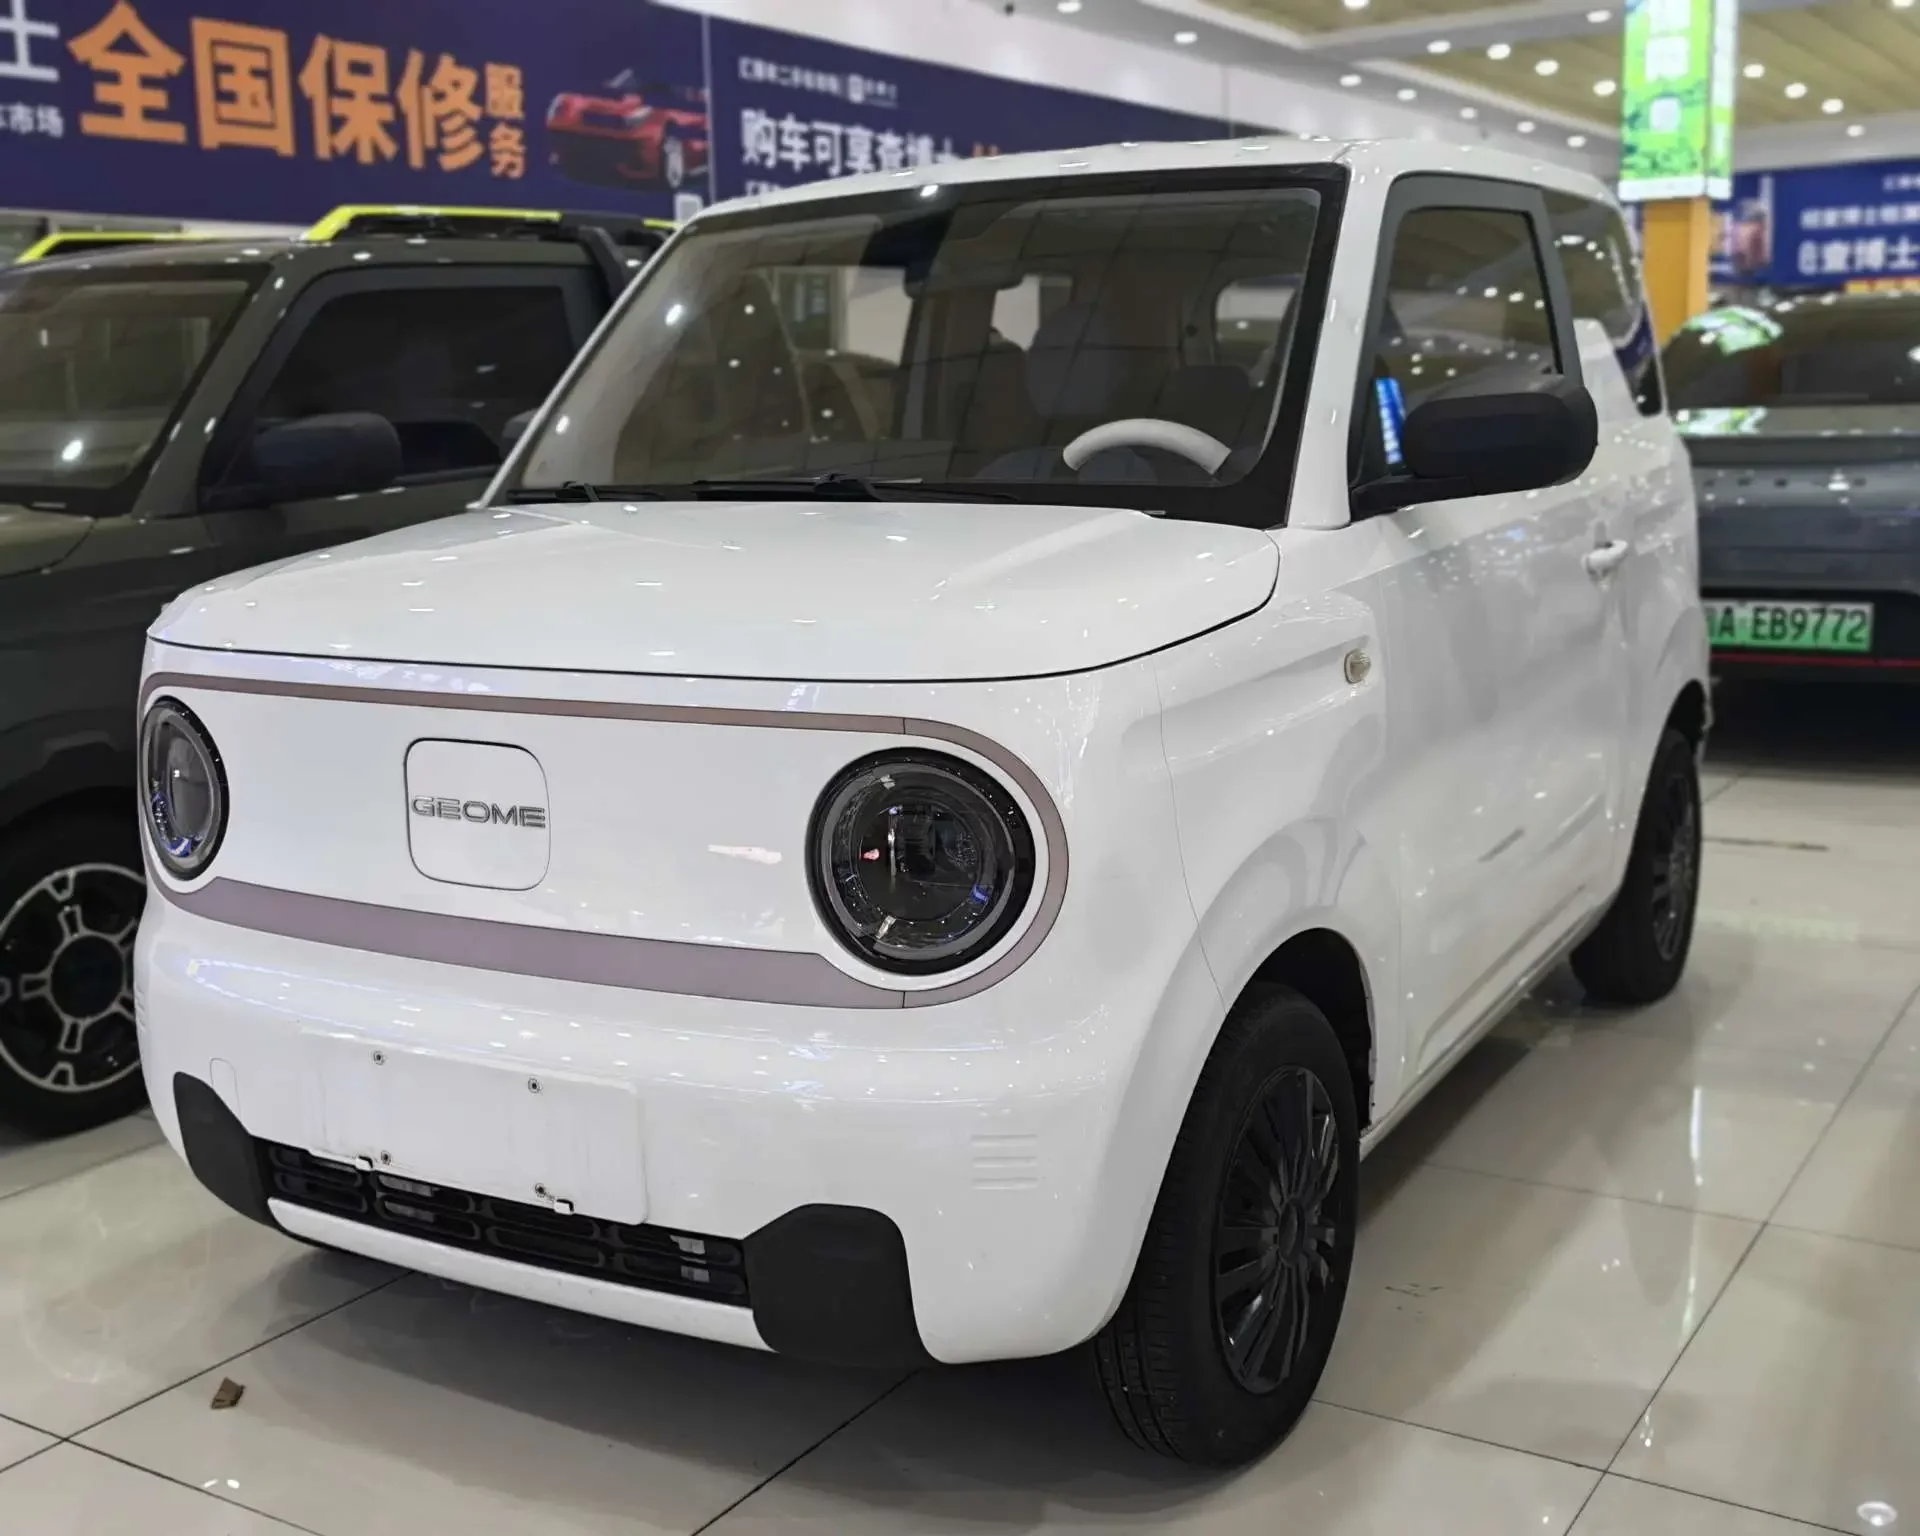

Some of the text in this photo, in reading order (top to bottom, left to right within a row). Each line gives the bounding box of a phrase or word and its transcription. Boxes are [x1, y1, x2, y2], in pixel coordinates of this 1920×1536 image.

[66, 0, 485, 172] 全国保修
[1751, 606, 1867, 642] EB9772
[411, 795, 546, 828] GEOME
